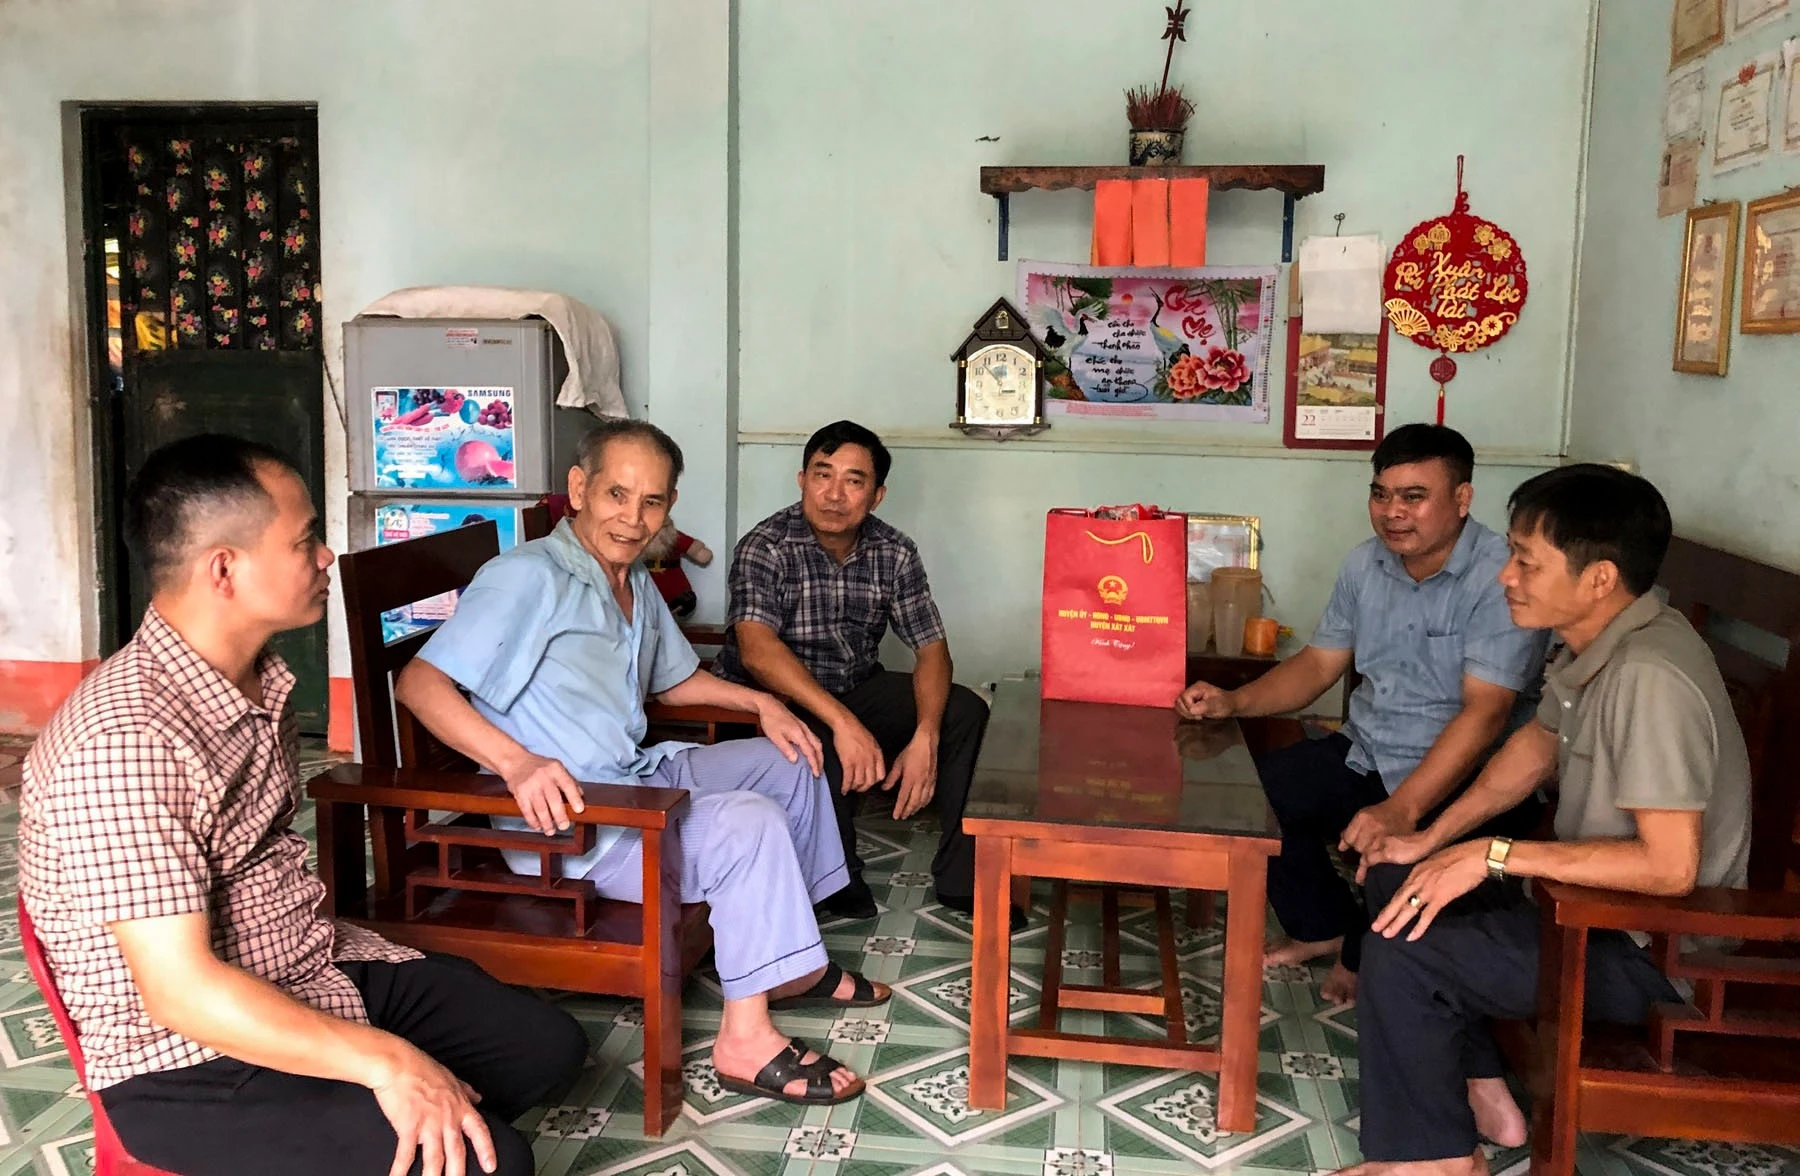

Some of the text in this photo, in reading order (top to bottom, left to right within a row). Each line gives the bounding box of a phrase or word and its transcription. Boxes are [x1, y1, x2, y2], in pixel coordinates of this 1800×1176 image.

[1430, 251, 1486, 279] Xuân
[1484, 274, 1521, 304] Lộc
[1182, 316, 1216, 346] Mẹ
[996, 353, 1007, 362] 12
[1019, 368, 1027, 376] 2
[1303, 415, 1316, 424] 22
